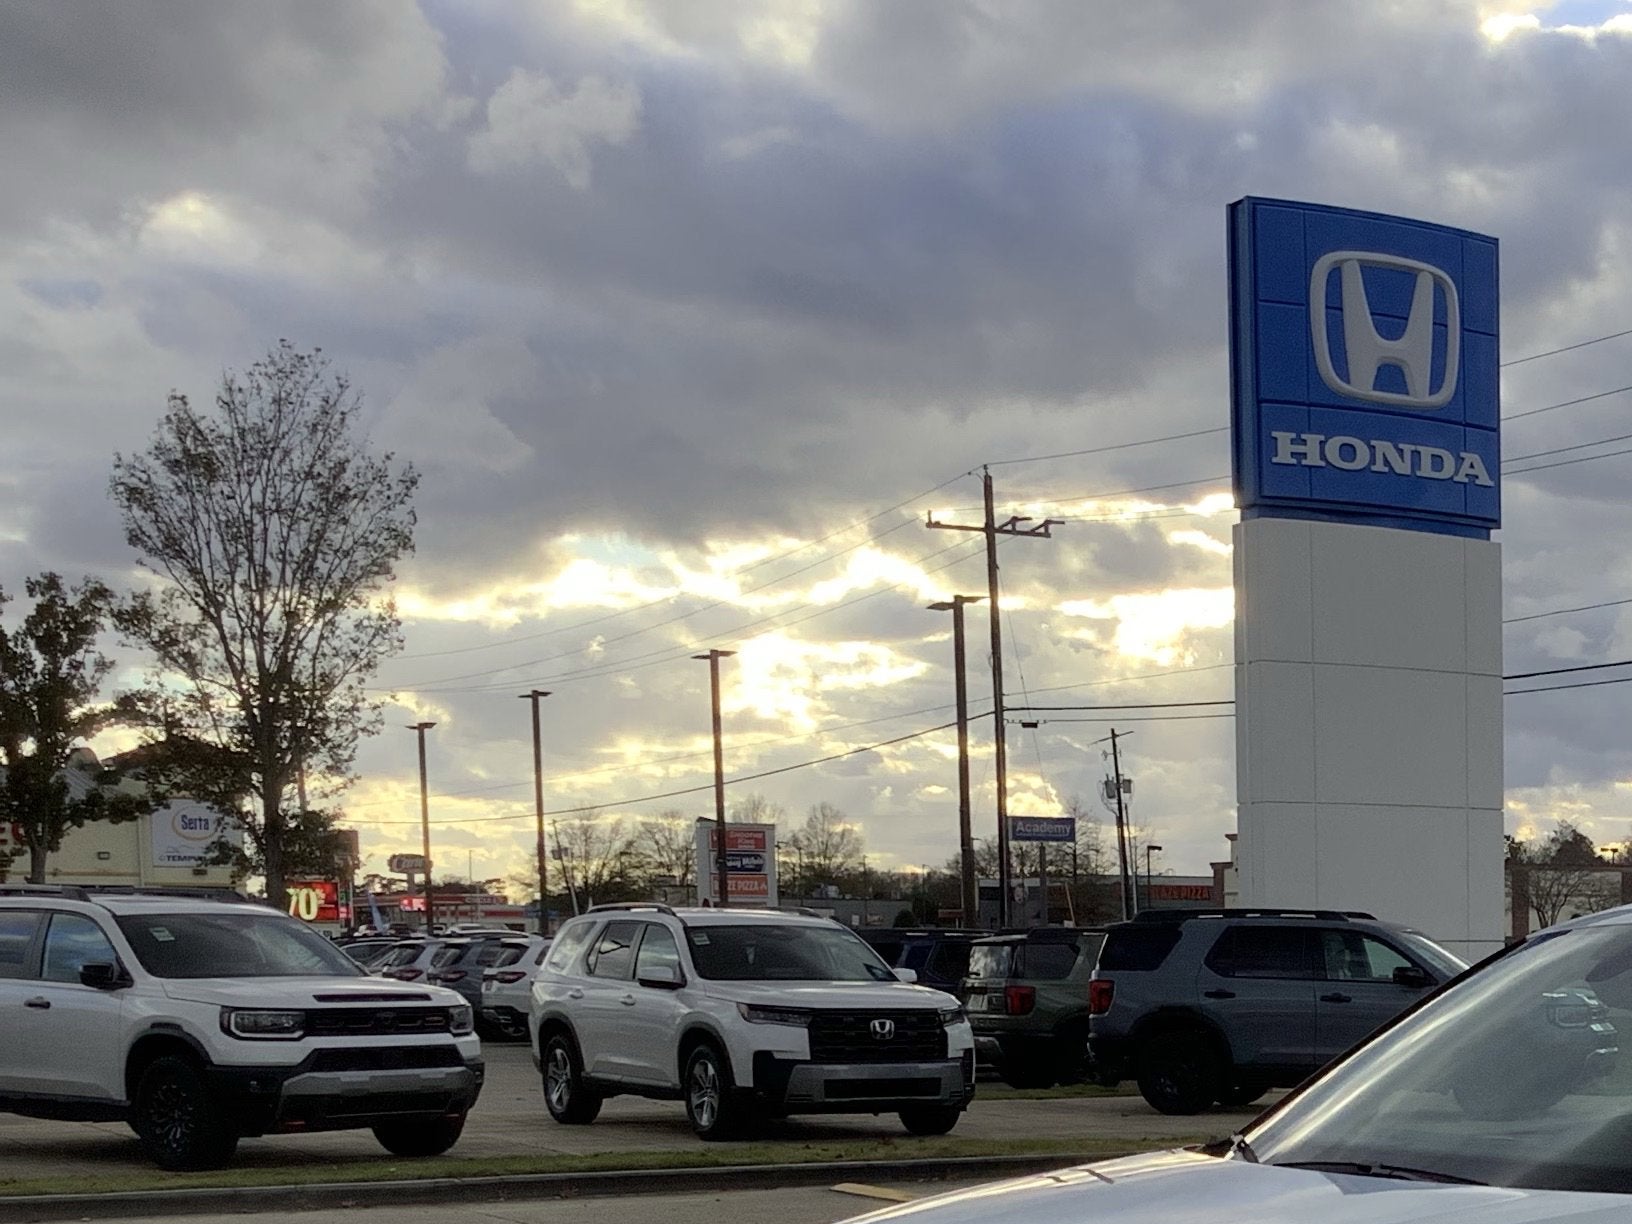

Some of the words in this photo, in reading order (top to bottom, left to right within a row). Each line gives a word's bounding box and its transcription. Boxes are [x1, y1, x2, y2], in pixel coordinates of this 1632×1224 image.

[1271, 431, 1495, 487] HONDA
[181, 814, 210, 831] Serta
[1015, 821, 1072, 837] Academy
[737, 880, 759, 890] PIZZA
